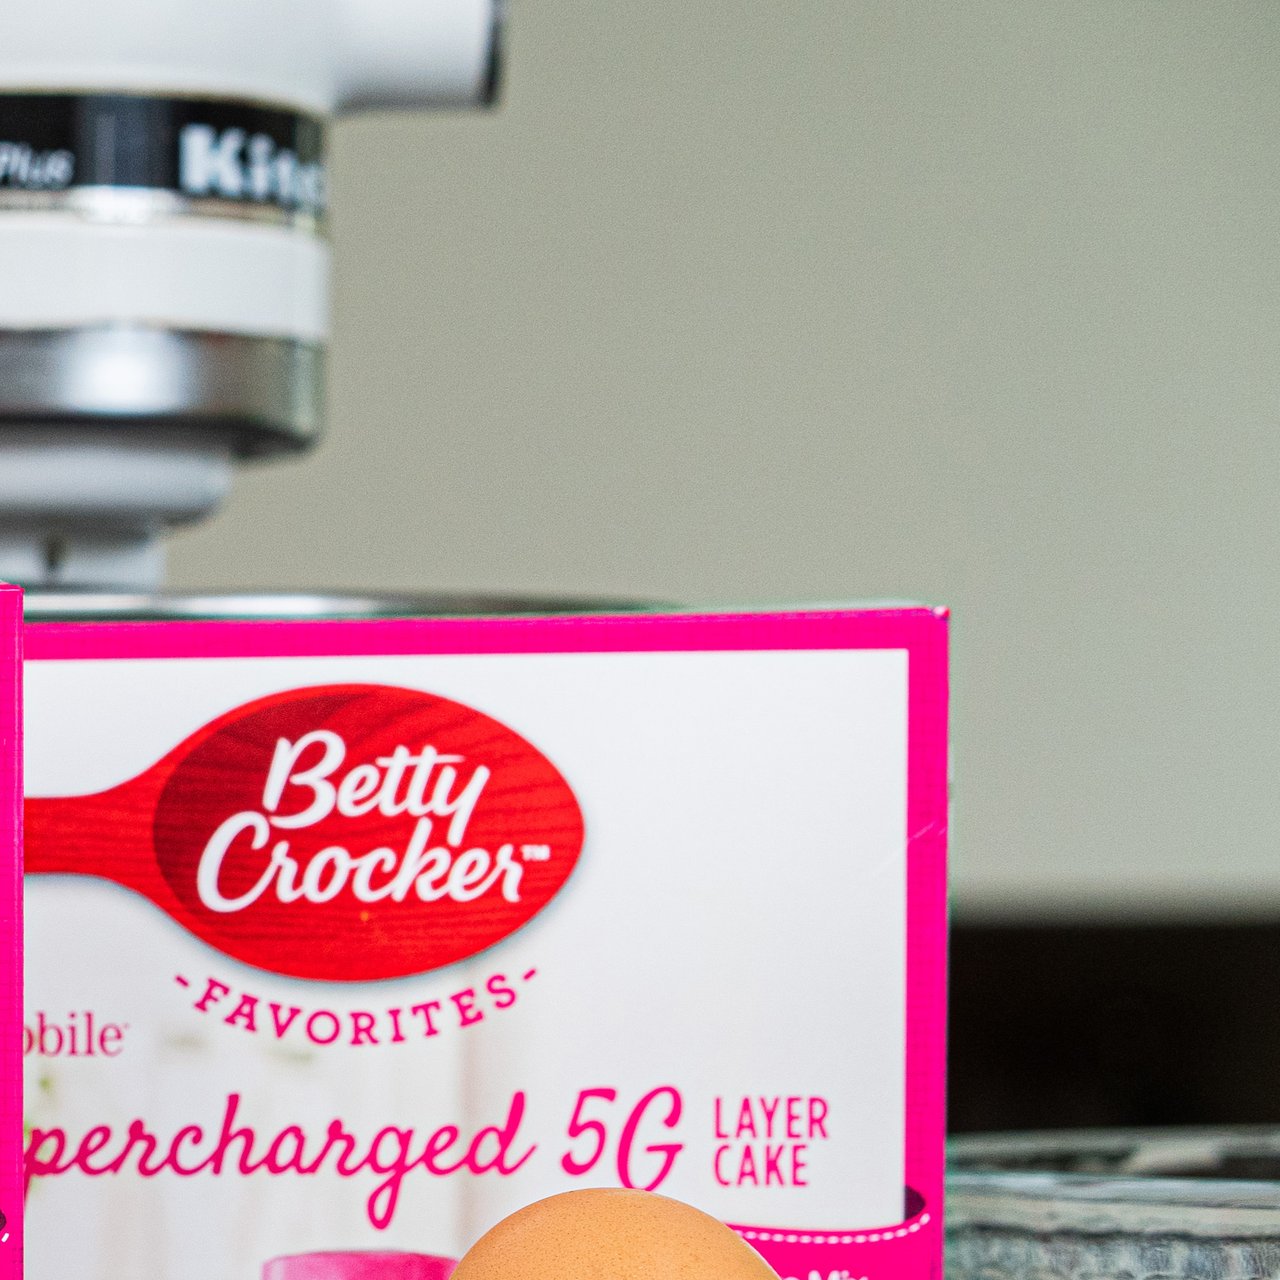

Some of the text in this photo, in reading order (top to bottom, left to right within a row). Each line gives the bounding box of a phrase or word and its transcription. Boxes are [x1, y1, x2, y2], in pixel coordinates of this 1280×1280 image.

[262, 729, 490, 847] Betty
[561, 1085, 683, 1191] 5G
[715, 1096, 829, 1141] LAYER
[715, 1143, 809, 1188] CAKE
